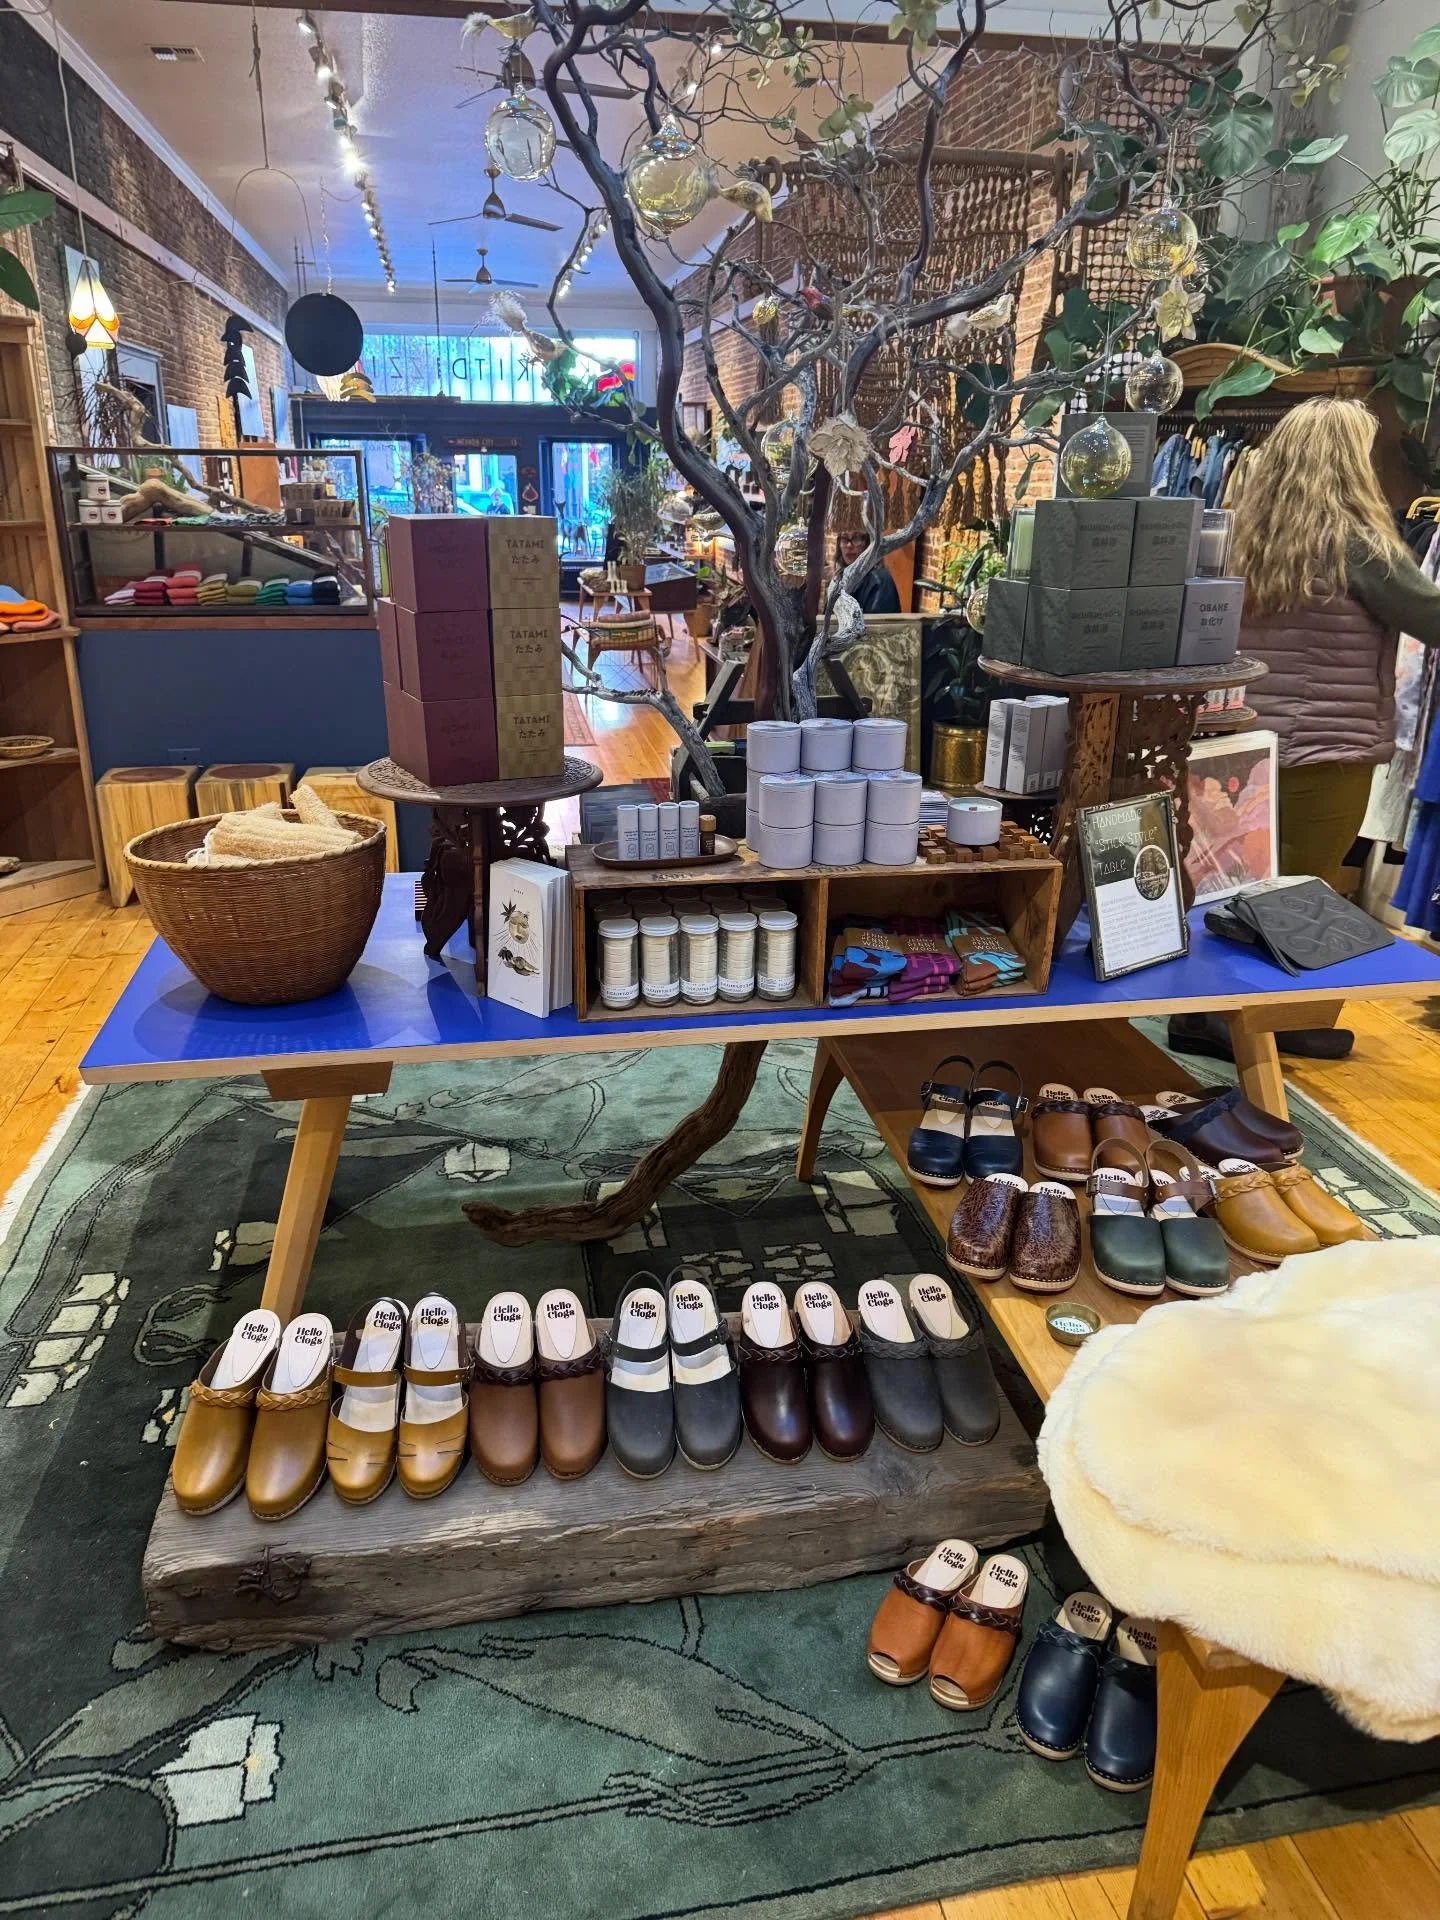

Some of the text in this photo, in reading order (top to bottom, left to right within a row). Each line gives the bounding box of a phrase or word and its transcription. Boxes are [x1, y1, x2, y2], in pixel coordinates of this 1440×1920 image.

[505, 539, 544, 548] TATAMI
[1200, 603, 1229, 612] OBAKE
[510, 629, 548, 639] TATAMI
[513, 714, 550, 724] TATAMI
[1101, 1173, 1127, 1181] Hello
[1040, 1187, 1066, 1195] Hello
[865, 1290, 890, 1300] Hello
[917, 1285, 942, 1295] Hello
[675, 1293, 700, 1302] Hello
[752, 1293, 776, 1302] Hello
[804, 1292, 828, 1301] Hello
[920, 1292, 947, 1302] Clogs
[546, 1301, 571, 1311] Hello
[631, 1301, 655, 1310] Hello
[676, 1301, 704, 1311] Clogs
[752, 1301, 780, 1310] Clogs
[805, 1300, 833, 1309] Clogs
[867, 1298, 894, 1307] Clogs
[421, 1307, 447, 1316] Hello
[493, 1305, 519, 1314] Hello
[547, 1309, 575, 1319] Clogs
[630, 1308, 657, 1319] Clogs
[375, 1310, 400, 1321] Hello
[493, 1312, 522, 1322] Clogs
[373, 1320, 401, 1331] Clogs
[420, 1316, 450, 1326] Clogs
[243, 1322, 269, 1333] Hello
[296, 1327, 322, 1336] Hello
[241, 1331, 268, 1342] Clogs
[294, 1335, 323, 1346] Clogs
[941, 1546, 967, 1563] Hello
[938, 1553, 965, 1569] Clogs
[991, 1563, 1019, 1580] Hello
[989, 1570, 1018, 1588] Clogs
[1072, 1600, 1101, 1616] Hello
[1070, 1607, 1101, 1623] Clogs
[1128, 1626, 1157, 1643] Hello
